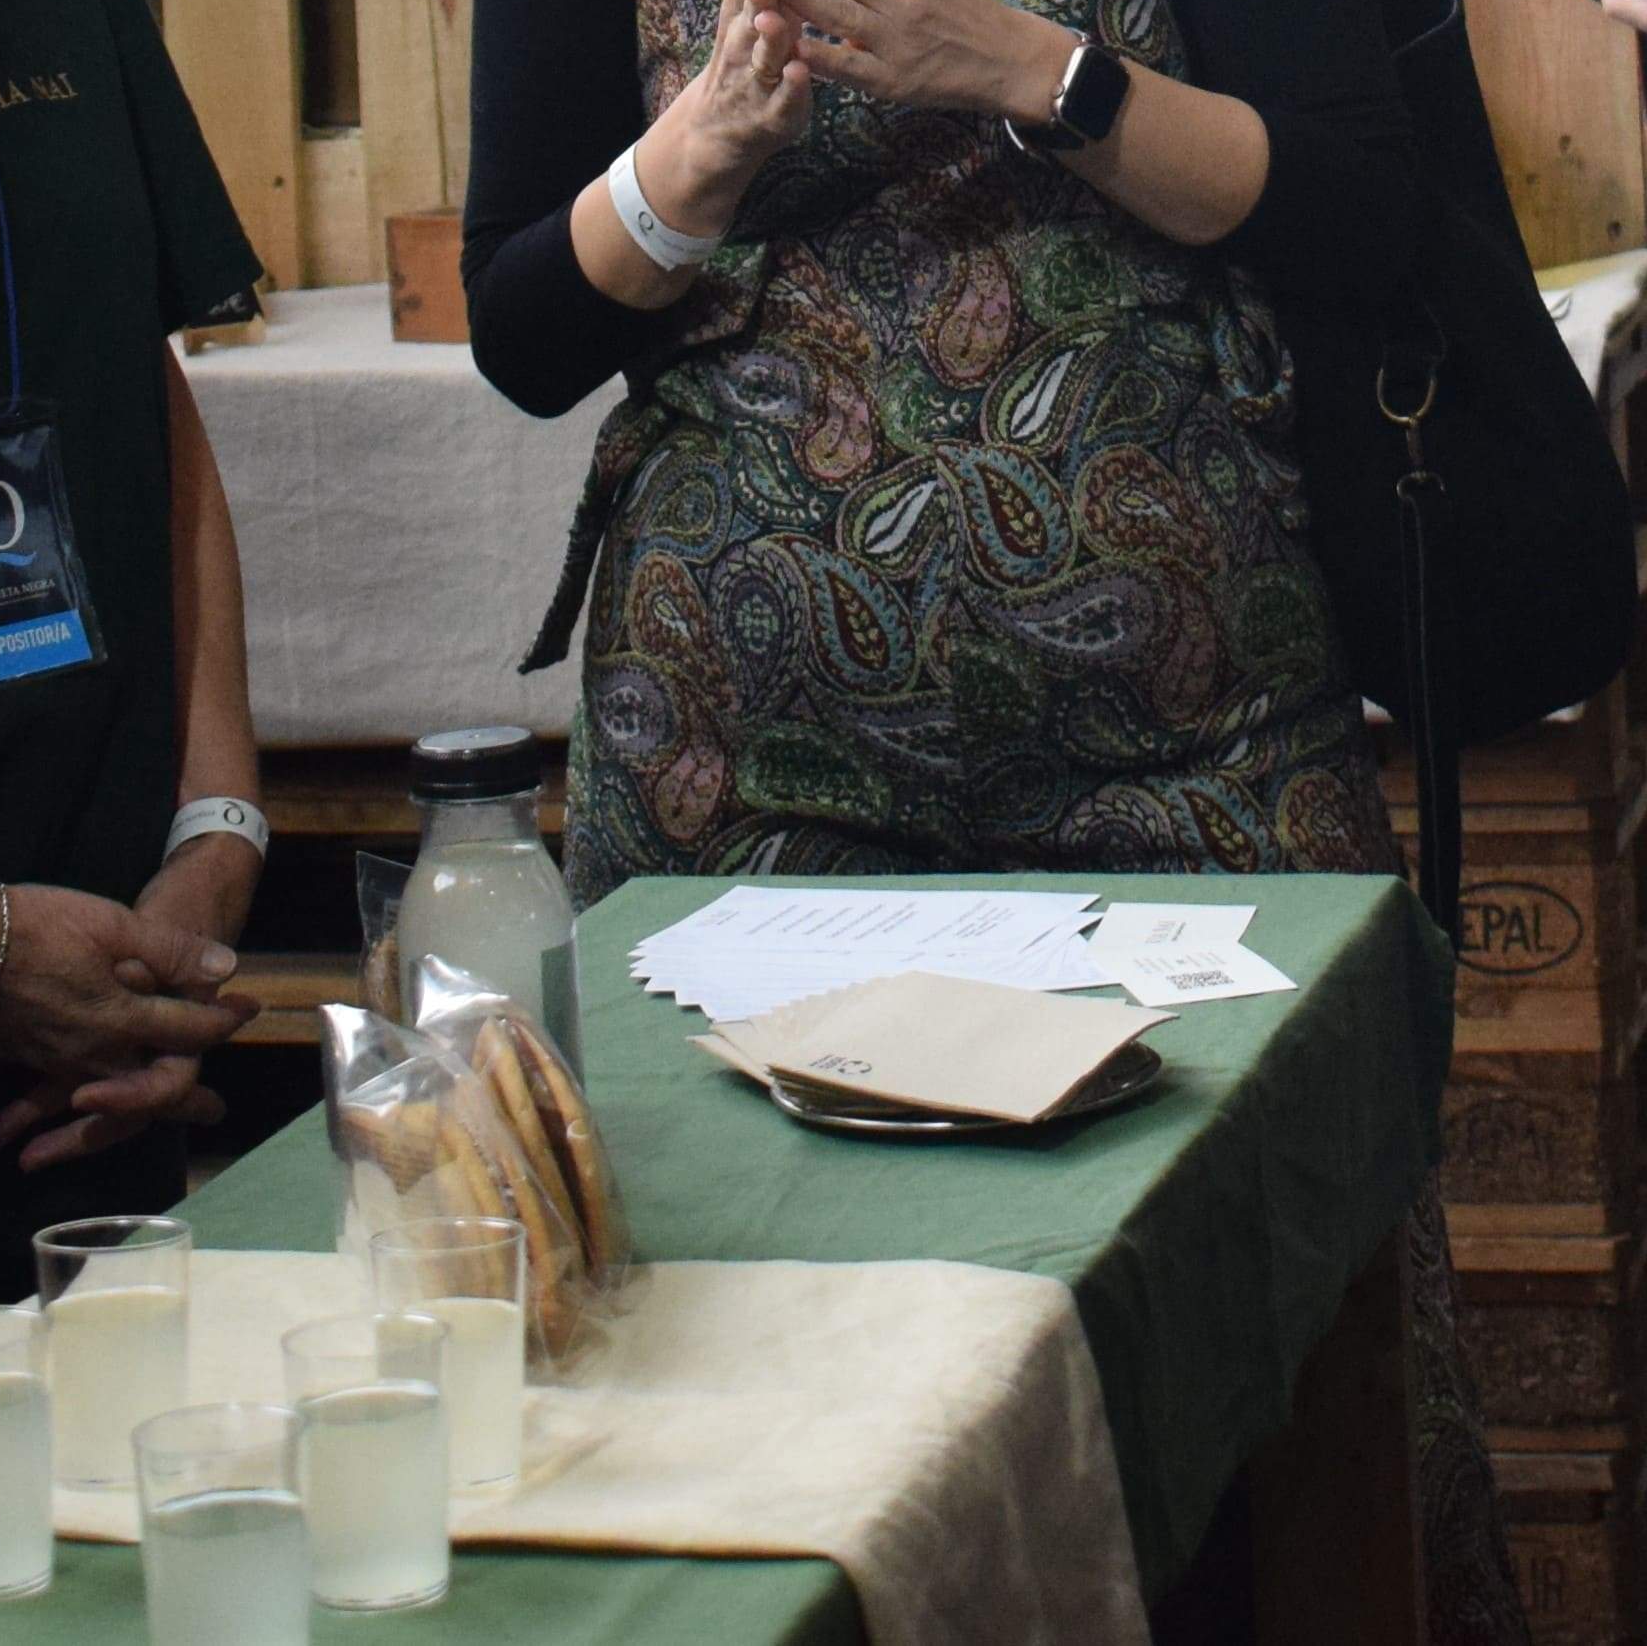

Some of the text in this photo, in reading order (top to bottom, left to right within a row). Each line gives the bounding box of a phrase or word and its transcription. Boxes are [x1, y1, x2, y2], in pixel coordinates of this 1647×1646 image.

[30, 72, 80, 100] NAI
[21, 578, 56, 595] NEGRA
[1460, 902, 1558, 953] EPAL
